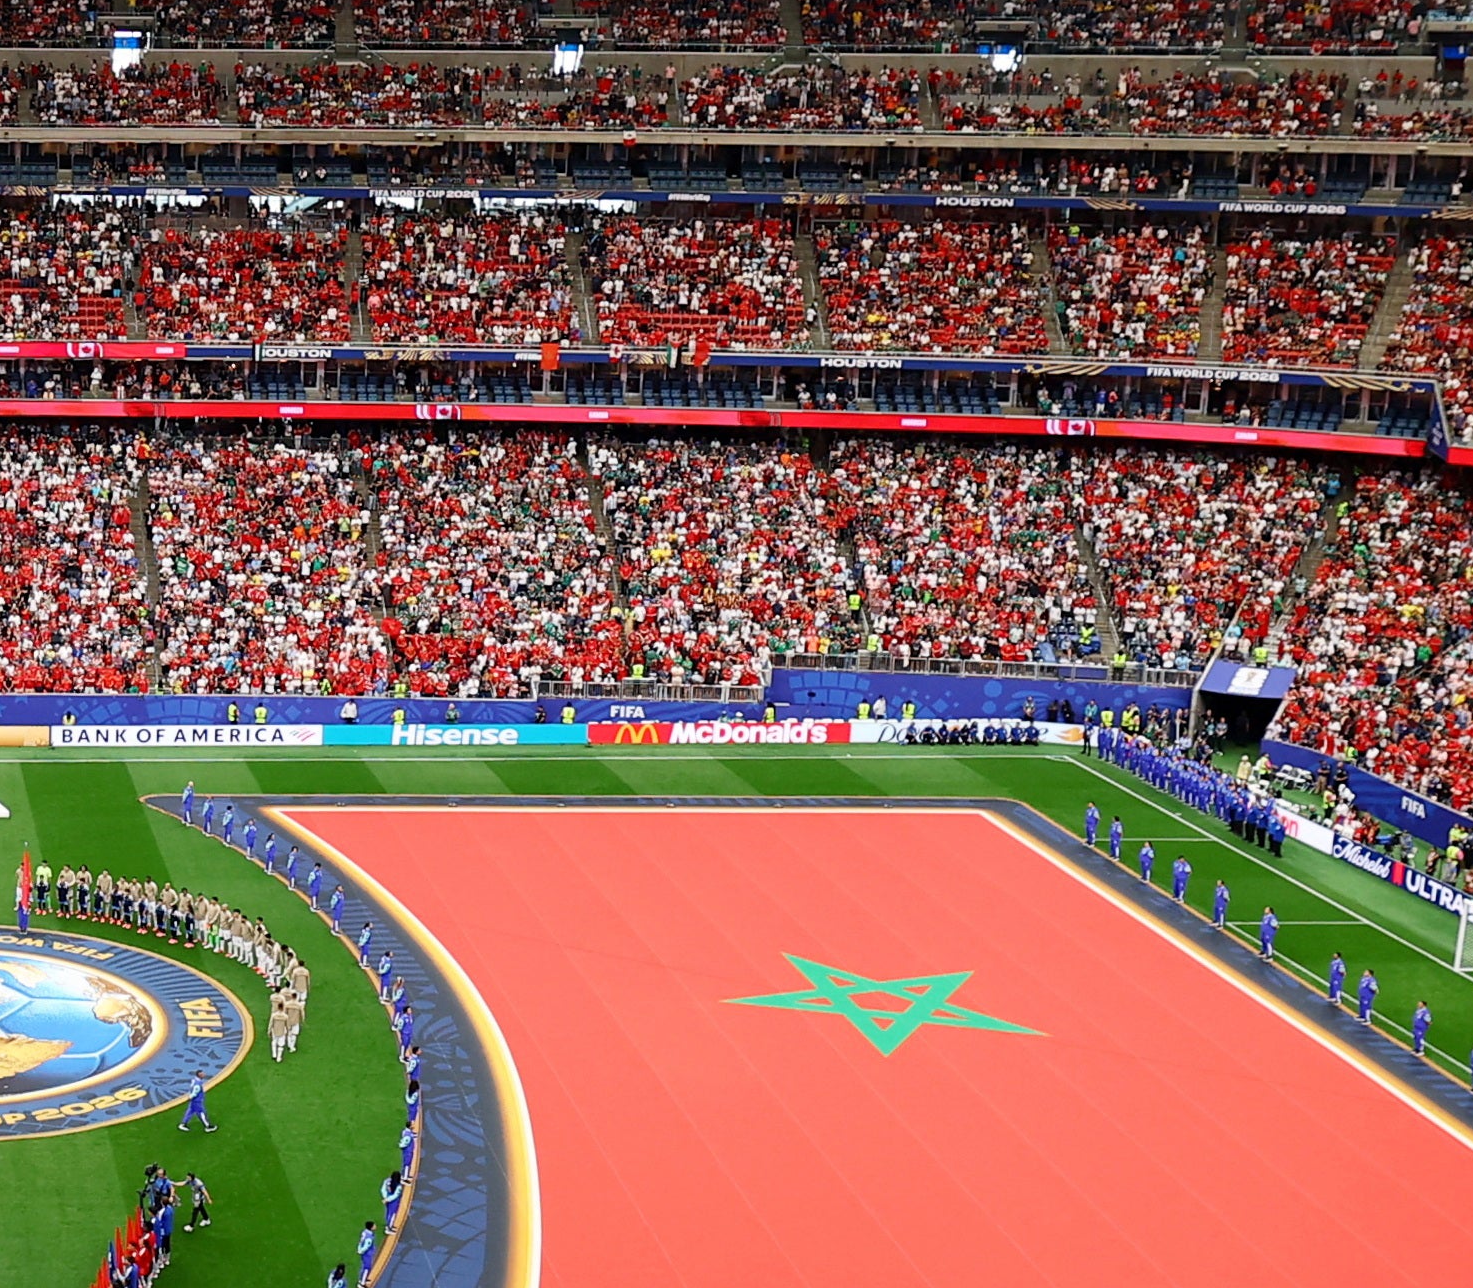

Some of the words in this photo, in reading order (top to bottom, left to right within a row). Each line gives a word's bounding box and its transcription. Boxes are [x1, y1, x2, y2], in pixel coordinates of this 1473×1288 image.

[369, 189, 391, 198] FIFA
[392, 189, 425, 198] WORLD
[426, 190, 445, 198] CUP
[446, 190, 480, 199] 2026
[935, 197, 1015, 207] HOUSTON
[1219, 202, 1243, 212] FIFA
[1244, 202, 1283, 213] WORLD
[1284, 203, 1306, 214] CUP
[1307, 205, 1347, 215] 2026
[820, 358, 902, 369] HOUSTON
[1146, 367, 1171, 377] FIFA
[1172, 368, 1213, 378] WORLD
[1214, 369, 1239, 380] CUP
[1239, 371, 1280, 382] 2026
[609, 706, 645, 719] FIFA
[61, 728, 128, 744] BANK
[136, 728, 166, 744] OF
[172, 728, 285, 744] AMERICA
[391, 724, 519, 745] Hisense
[669, 723, 828, 744] McDonald's
[1400, 795, 1427, 820] FIFA
[1333, 834, 1391, 879] Michelob
[1405, 869, 1465, 916] ULTRA
[51, 939, 115, 962] FIFA
[178, 997, 224, 1040] FIFA
[31, 1085, 148, 1122] 2026
